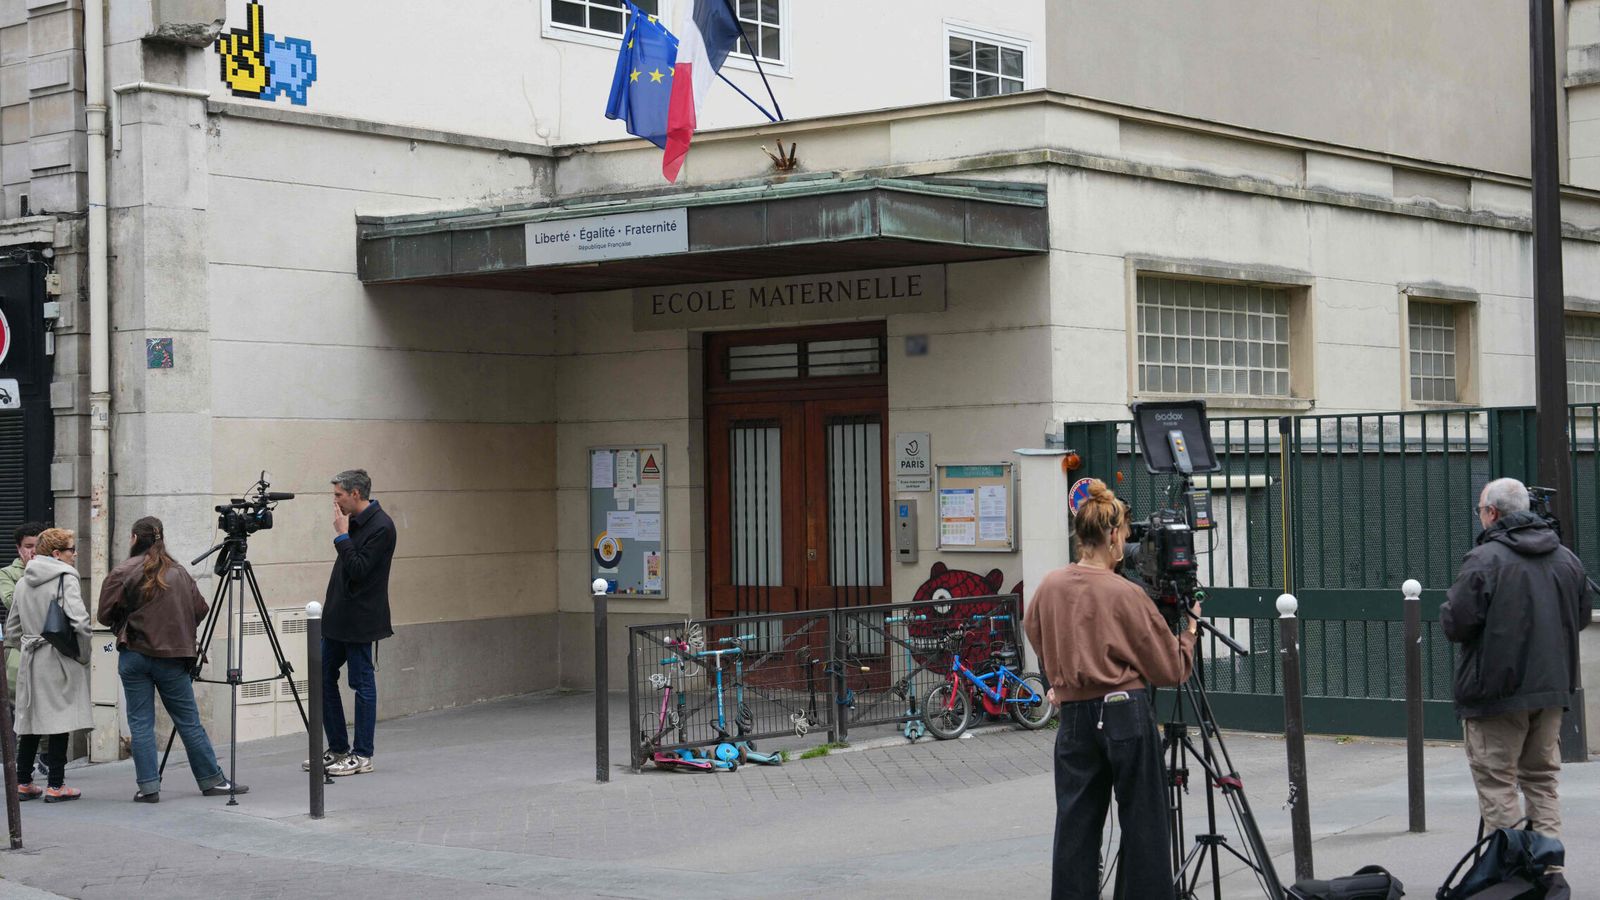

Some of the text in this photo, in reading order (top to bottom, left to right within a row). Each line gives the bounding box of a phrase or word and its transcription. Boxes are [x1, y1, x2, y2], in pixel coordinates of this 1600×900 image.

[535, 231, 570, 244] Liberté
[579, 227, 615, 242] Égalité
[625, 220, 677, 235] Fraternité
[578, 242, 607, 250] République
[652, 274, 922, 314] ECOLE MATERNELLE
[1155, 412, 1183, 421] Godox
[901, 461, 925, 469] PARIS
